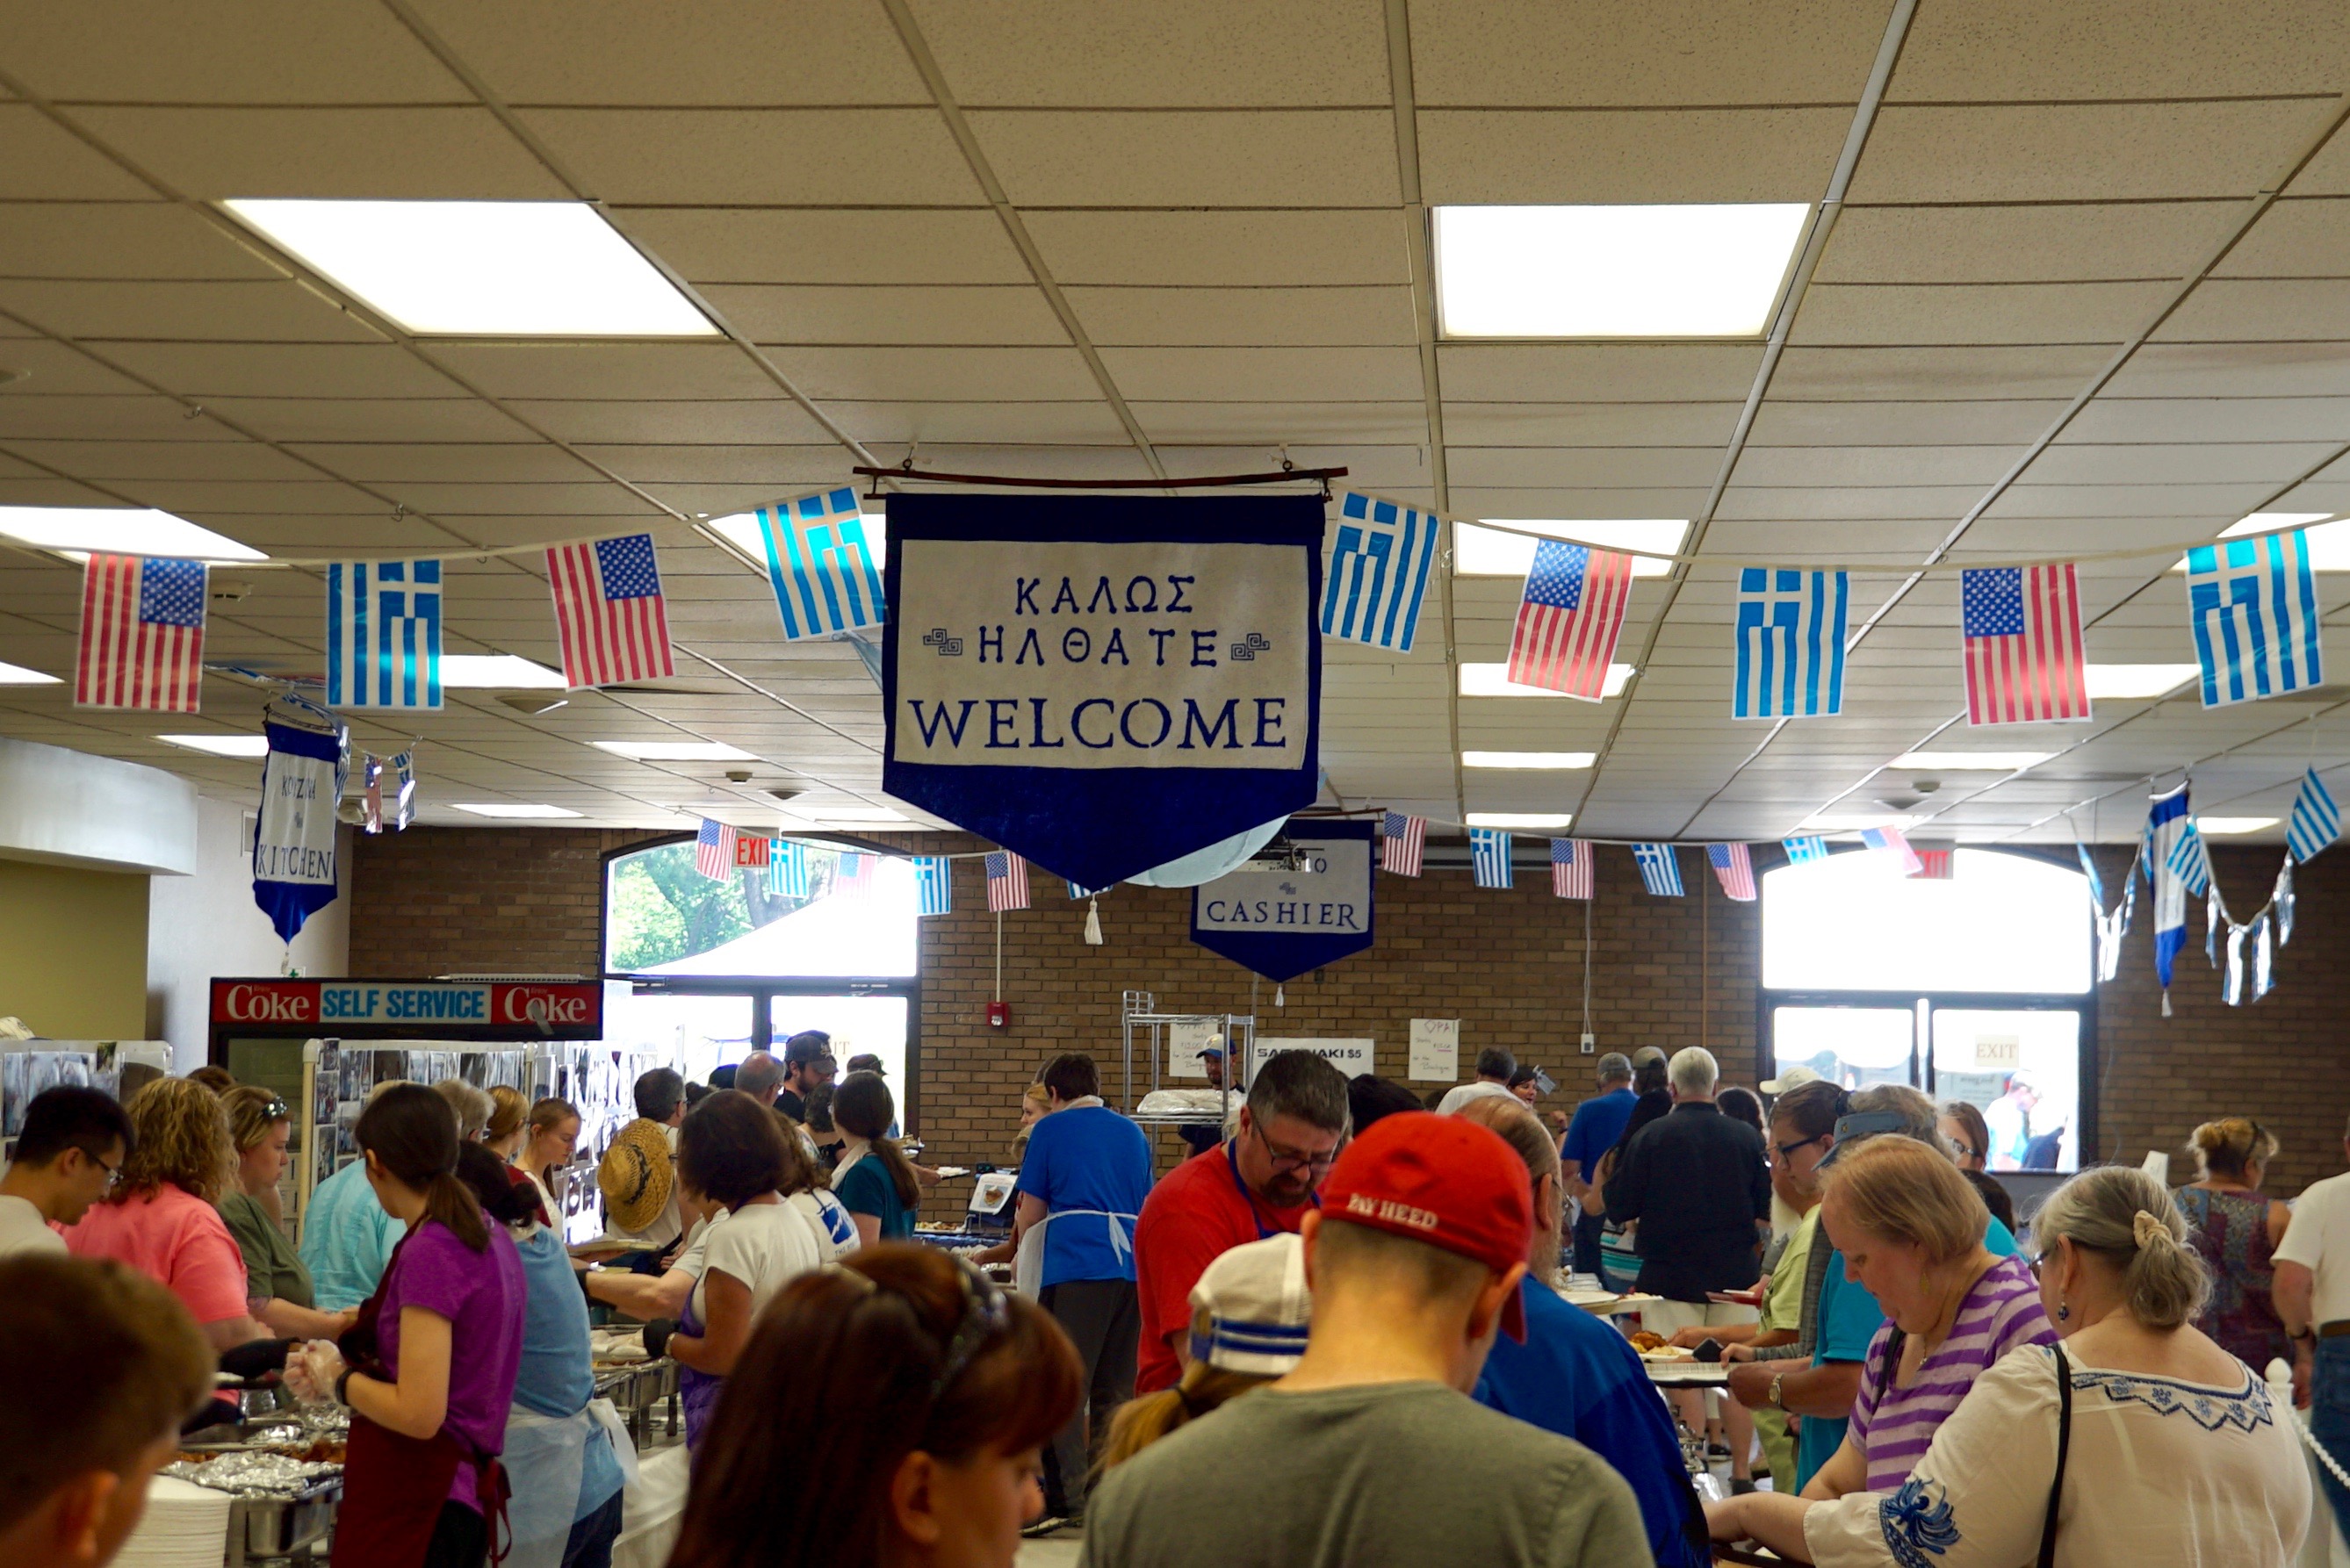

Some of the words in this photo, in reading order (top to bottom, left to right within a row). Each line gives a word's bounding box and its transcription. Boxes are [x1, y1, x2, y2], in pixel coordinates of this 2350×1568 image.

[907, 697, 1287, 750] WELCOME
[257, 844, 332, 879] KITCHEN
[1206, 900, 1361, 931] CASHIER
[227, 984, 311, 1021] Coke
[322, 989, 380, 1018] SELF
[386, 989, 485, 1018] SERVICE
[504, 986, 588, 1023] Coke
[1347, 1049, 1363, 1059] $5
[1976, 1043, 2016, 1059] EXIT
[1346, 1192, 1379, 1218] PAY
[1377, 1199, 1439, 1233] HEED
